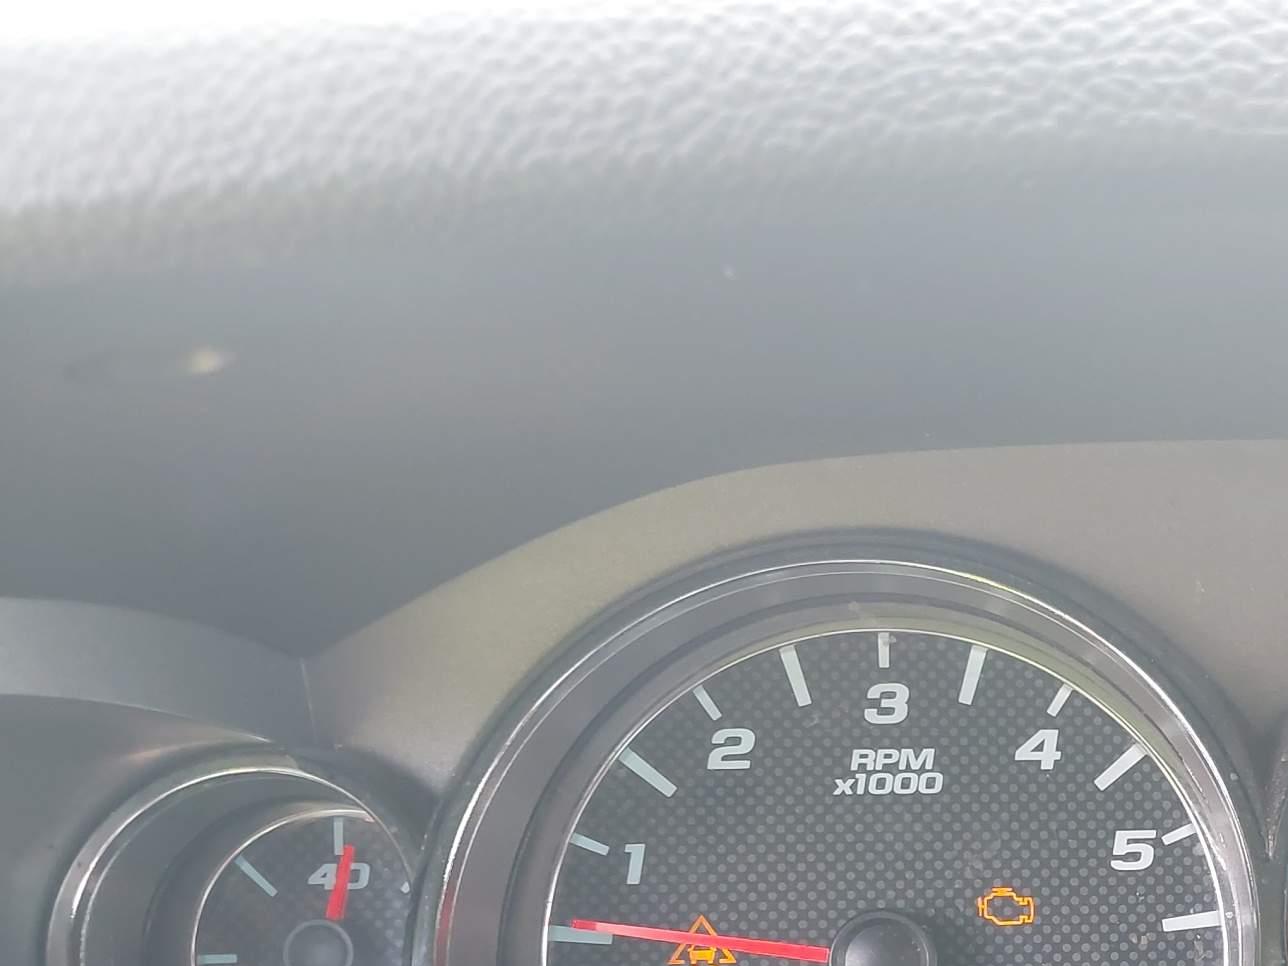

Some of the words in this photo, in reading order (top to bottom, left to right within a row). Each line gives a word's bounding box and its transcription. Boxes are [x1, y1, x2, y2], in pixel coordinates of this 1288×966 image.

[865, 684, 910, 724] 3
[707, 729, 755, 770] 2
[850, 749, 935, 770] RPM
[1015, 730, 1061, 770] 4
[834, 772, 943, 795] x1000
[624, 844, 644, 884] 1
[1111, 830, 1156, 871] 5
[307, 862, 370, 890] 40
